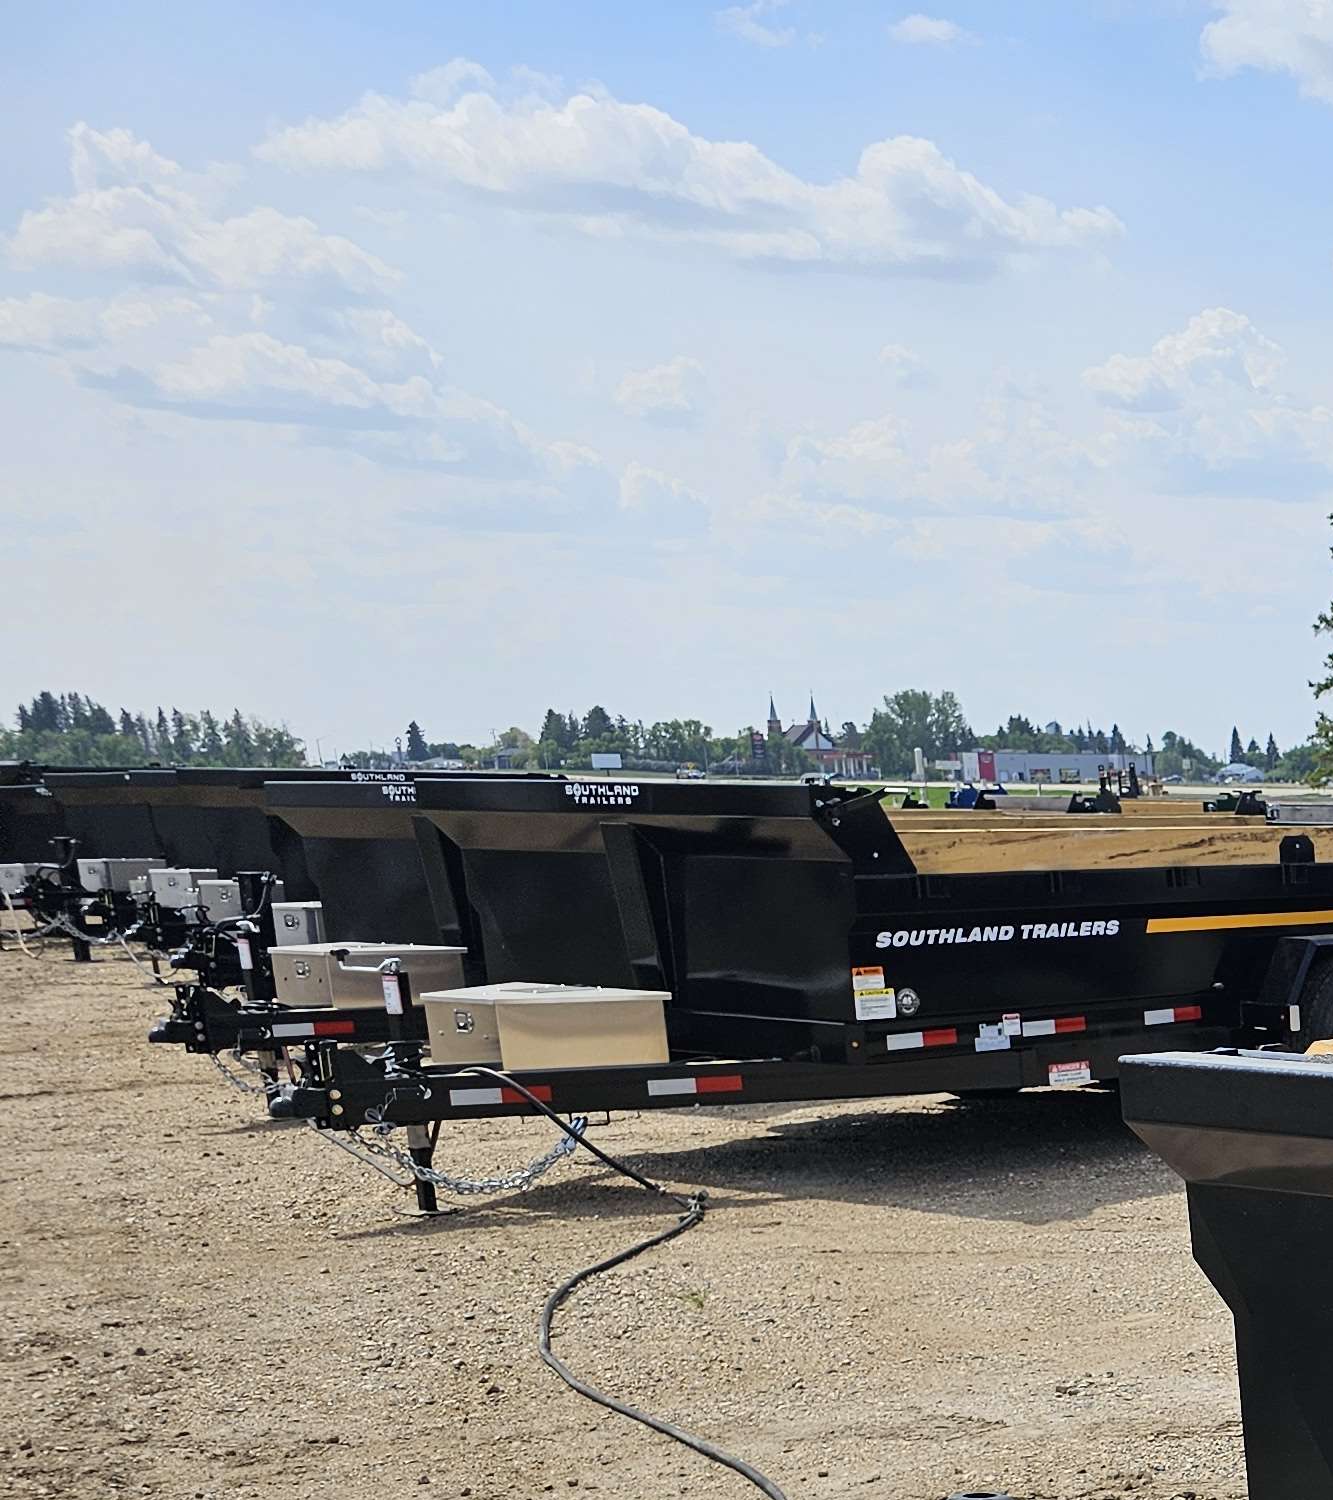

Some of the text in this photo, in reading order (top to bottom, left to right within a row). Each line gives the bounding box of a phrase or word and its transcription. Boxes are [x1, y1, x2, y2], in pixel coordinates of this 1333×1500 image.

[351, 772, 405, 781] SOUTHLAND
[382, 785, 416, 795] SOUTH
[565, 783, 639, 796] SOUTHLAND
[574, 796, 632, 805] TRAILERS
[876, 920, 1120, 949] SOUTHLAND TRAILERS
